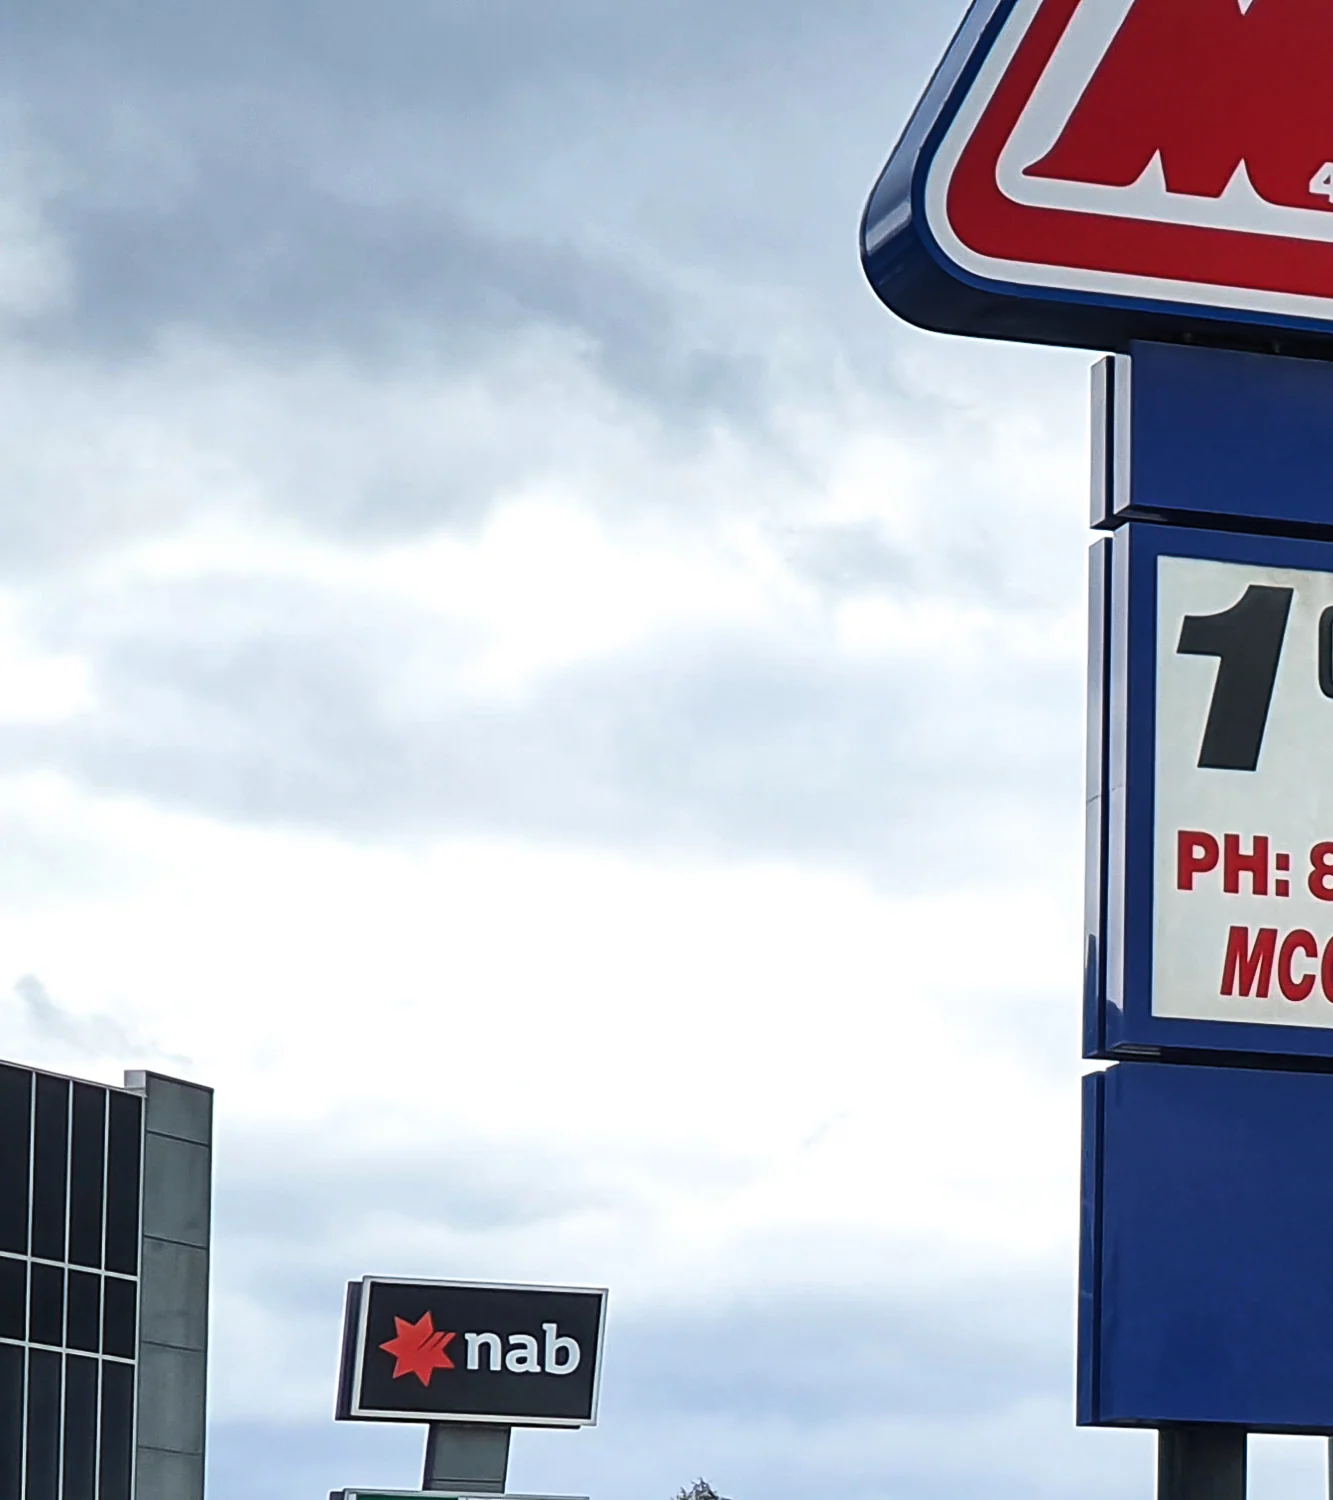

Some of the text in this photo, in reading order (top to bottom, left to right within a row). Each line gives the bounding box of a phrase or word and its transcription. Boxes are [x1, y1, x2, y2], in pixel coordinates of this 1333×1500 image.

[1177, 585, 1294, 771] 1
[1177, 830, 1291, 896] PH:
[465, 1323, 581, 1375] nab
